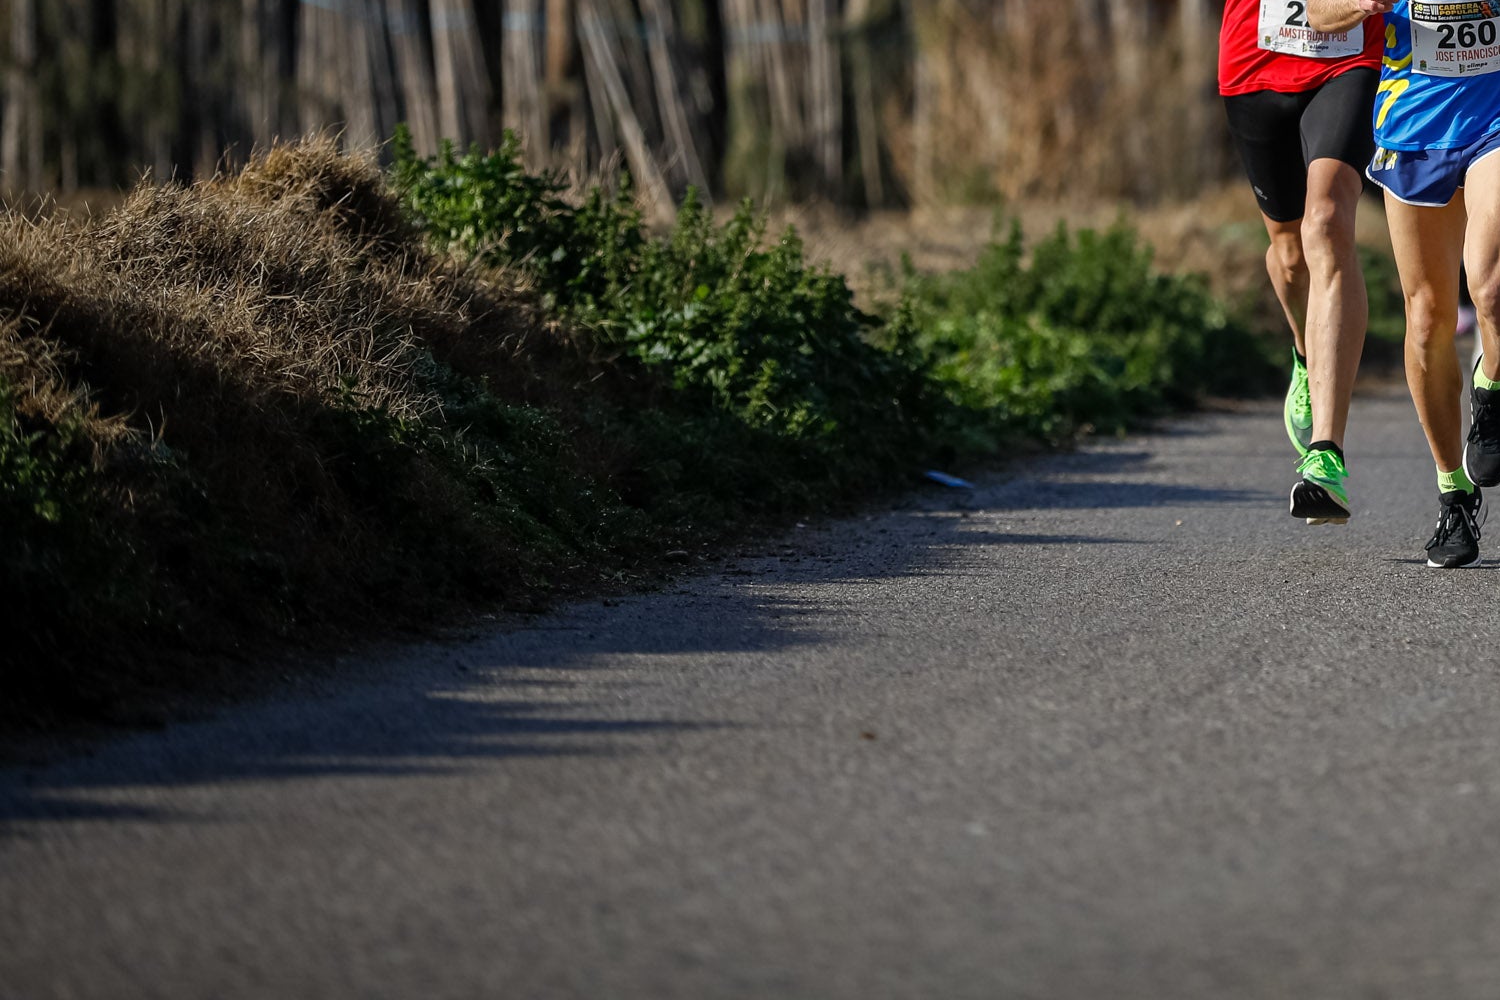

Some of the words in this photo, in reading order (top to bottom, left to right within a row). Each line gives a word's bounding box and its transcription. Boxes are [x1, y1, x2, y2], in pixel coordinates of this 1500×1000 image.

[1414, 3, 1423, 11] 26
[1430, 4, 1439, 15] VII
[1439, 2, 1480, 11] CARRERA
[1439, 8, 1480, 16] POPULAR
[1279, 27, 1330, 42] AMSTERDAM
[1332, 31, 1348, 42] PUB
[1436, 20, 1496, 49] 260
[1435, 51, 1454, 62] JOSE
